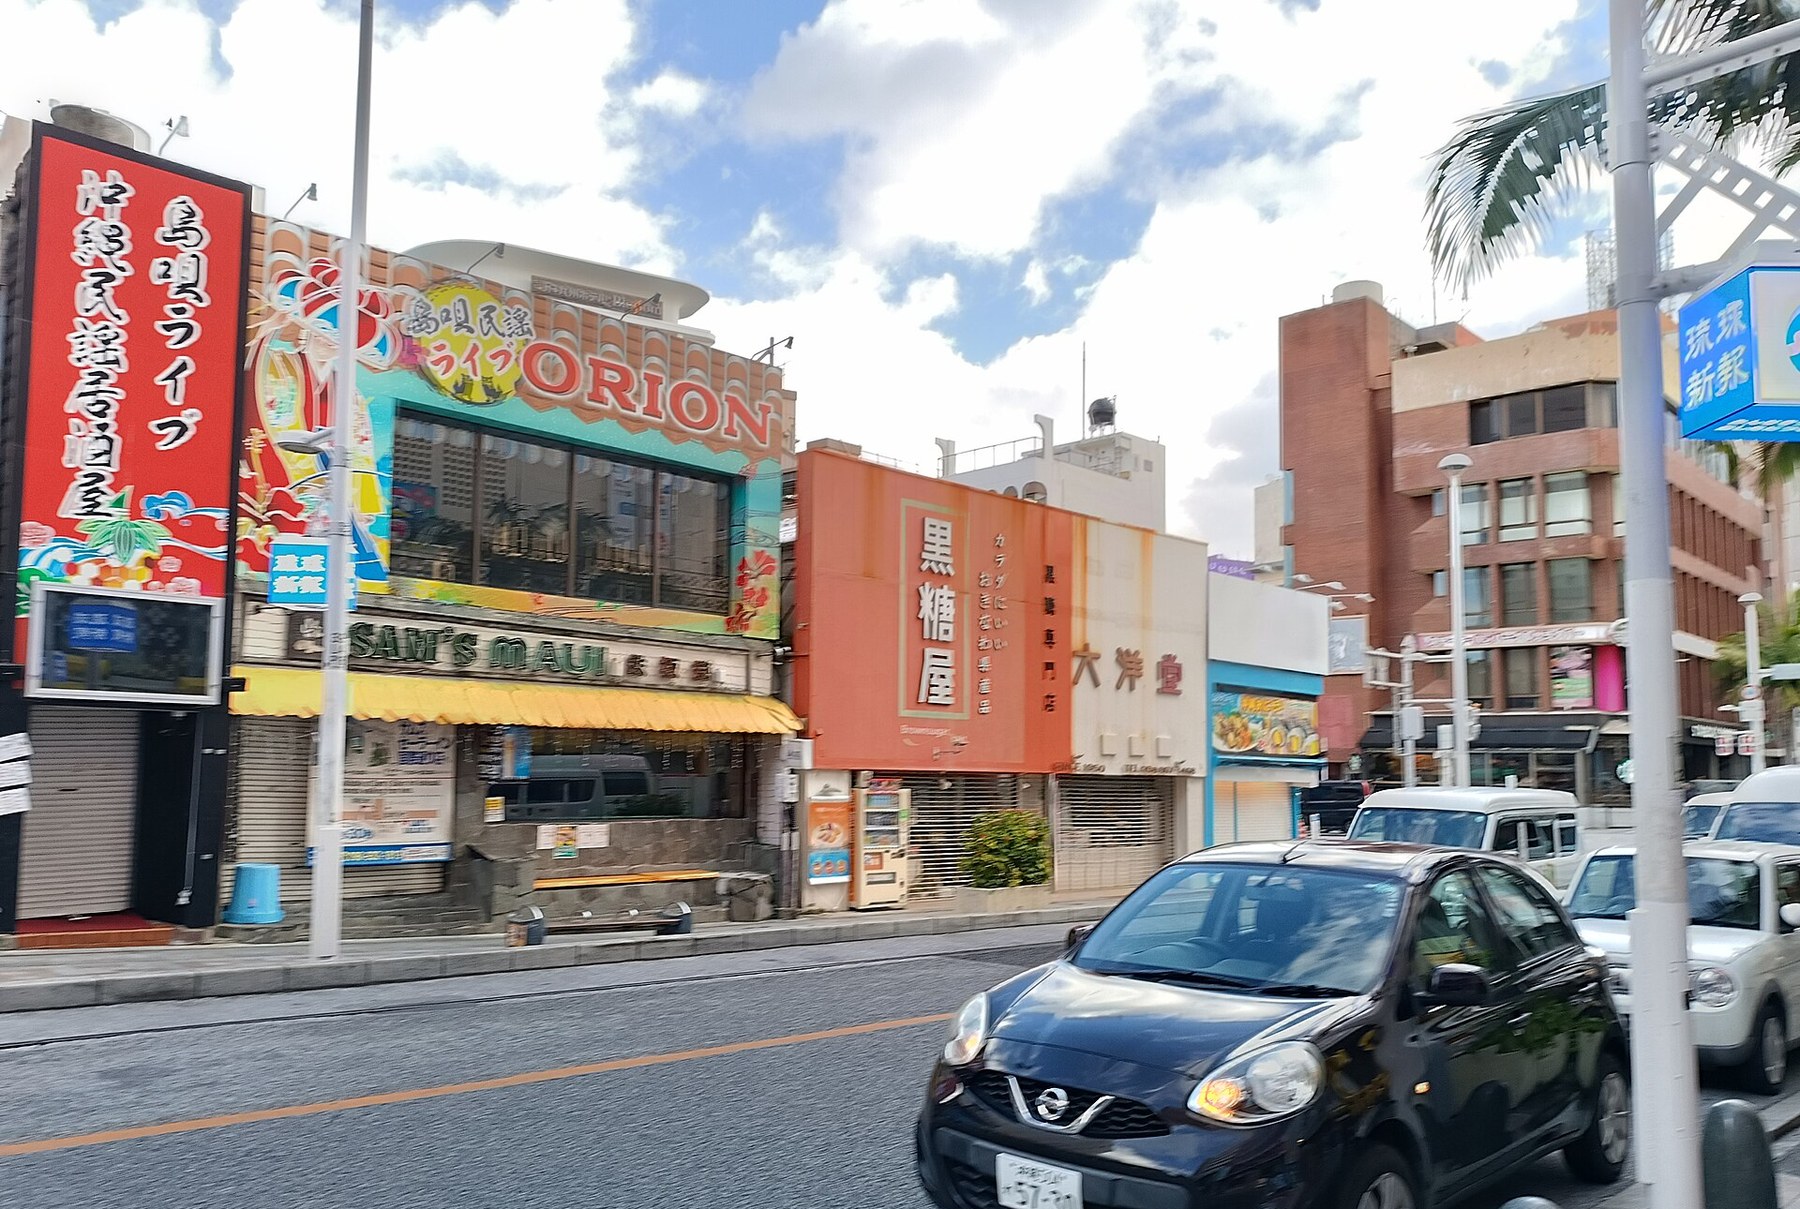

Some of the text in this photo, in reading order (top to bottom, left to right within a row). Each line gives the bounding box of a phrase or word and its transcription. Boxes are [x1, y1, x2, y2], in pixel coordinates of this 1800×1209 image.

[147, 196, 211, 451] 島唄ライブ
[401, 296, 536, 339] 島唄民謡
[429, 341, 516, 379] ライブ
[521, 341, 772, 446] ORION
[917, 516, 956, 705] 黒糖屋
[349, 621, 478, 668] SAM'S
[489, 634, 610, 678] MAUI
[1072, 642, 1182, 696] 大洋堂
